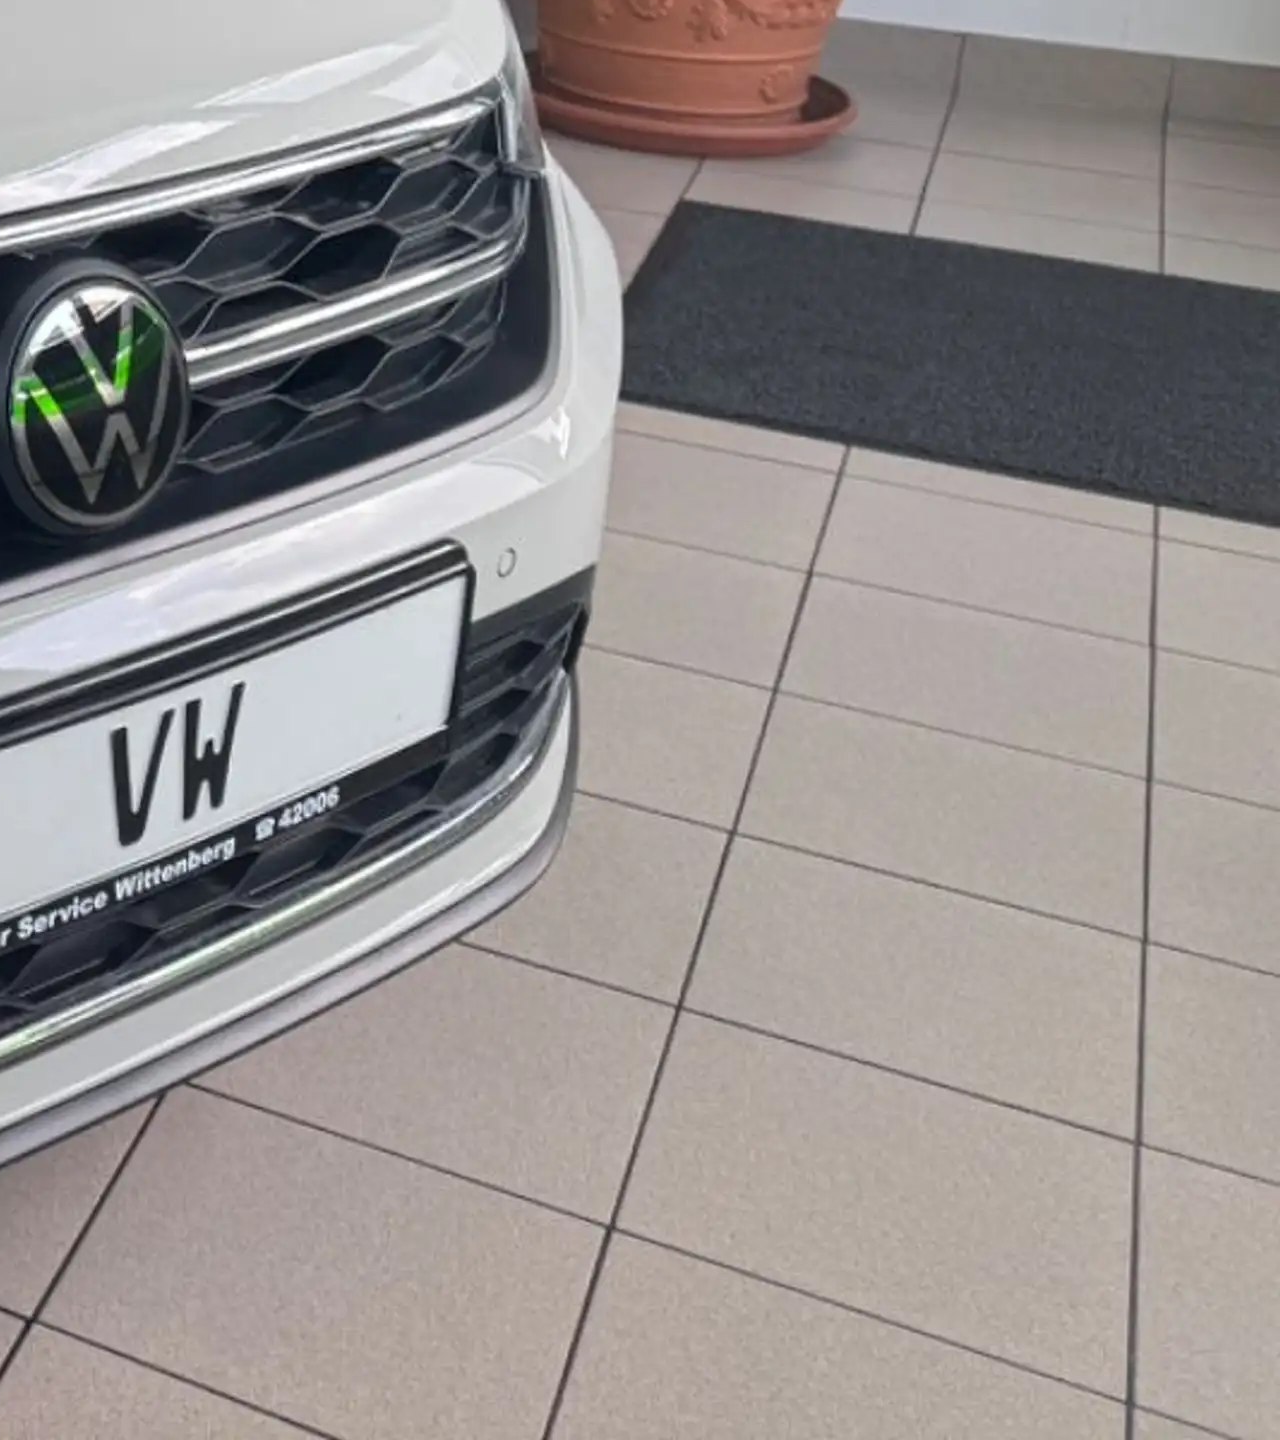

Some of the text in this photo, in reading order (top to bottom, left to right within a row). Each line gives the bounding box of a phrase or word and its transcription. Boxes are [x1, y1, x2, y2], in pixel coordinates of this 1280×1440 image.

[110, 681, 246, 847] VW
[17, 890, 108, 940] Service
[114, 835, 237, 902] Wittenberg
[277, 786, 340, 829] 42006
